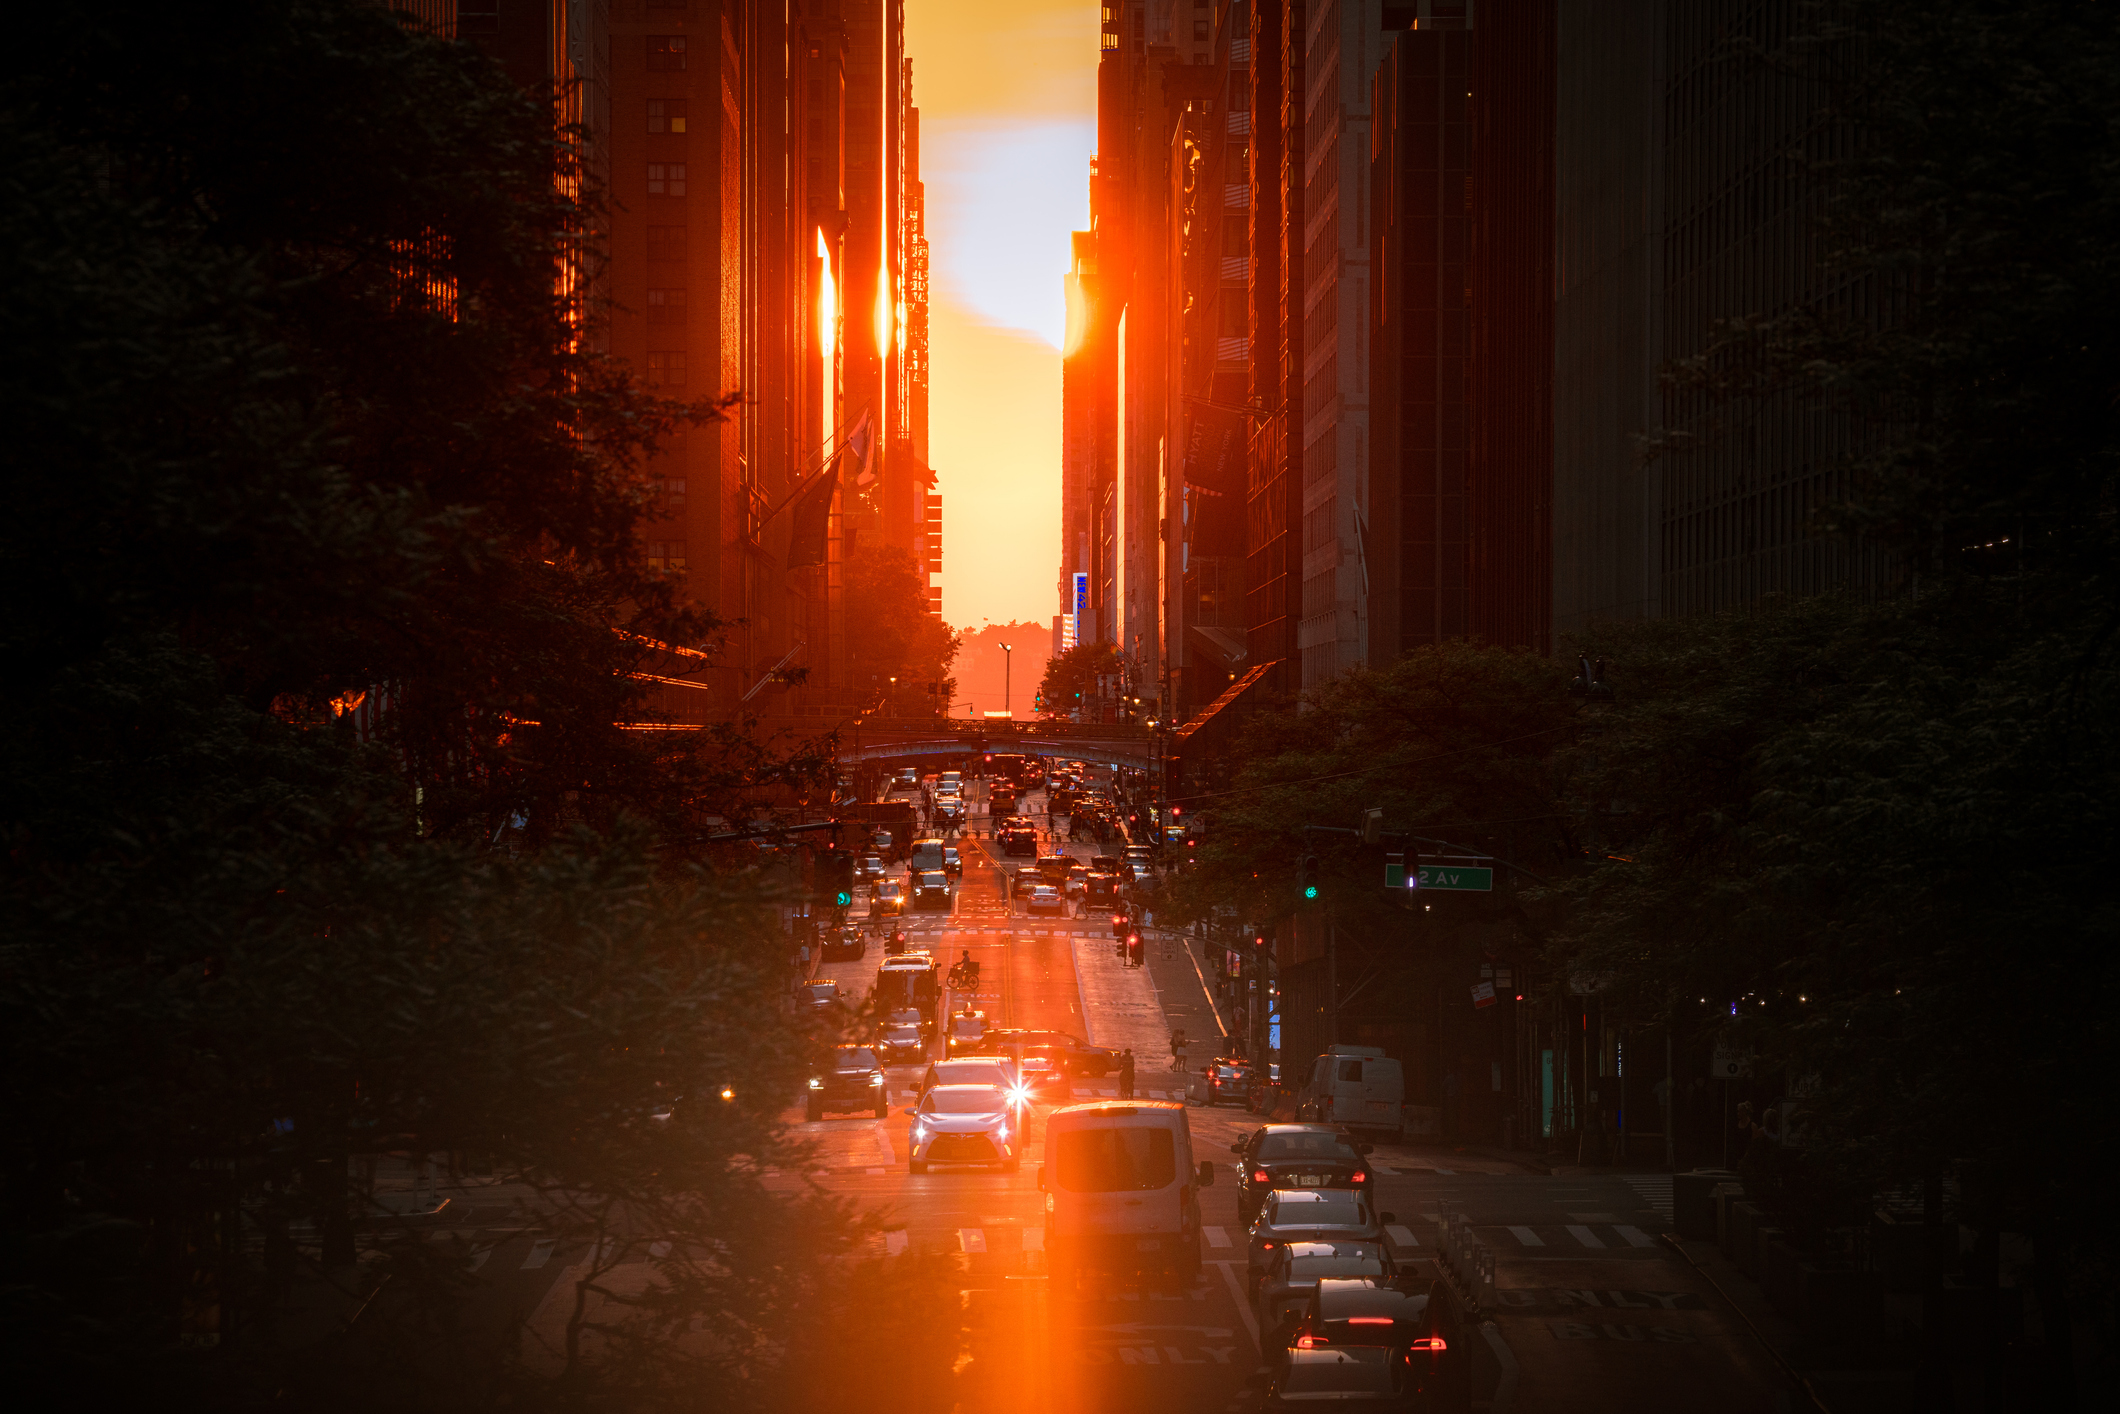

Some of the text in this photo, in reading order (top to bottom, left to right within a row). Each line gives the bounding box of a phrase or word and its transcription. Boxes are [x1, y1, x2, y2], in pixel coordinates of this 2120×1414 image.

[1188, 420, 1204, 464] HYATT
[1217, 429, 1232, 472] NEW YORK
[1077, 576, 1087, 593] NEW
[875, 745, 913, 756] SQUARE
[920, 743, 950, 751] PLAZA
[1009, 744, 1150, 767] GRAND CENTRAL TERMINA
[1418, 870, 1460, 885] 2 Av
[1106, 1287, 1214, 1302] NLY
[1548, 1322, 1698, 1344] BUS
